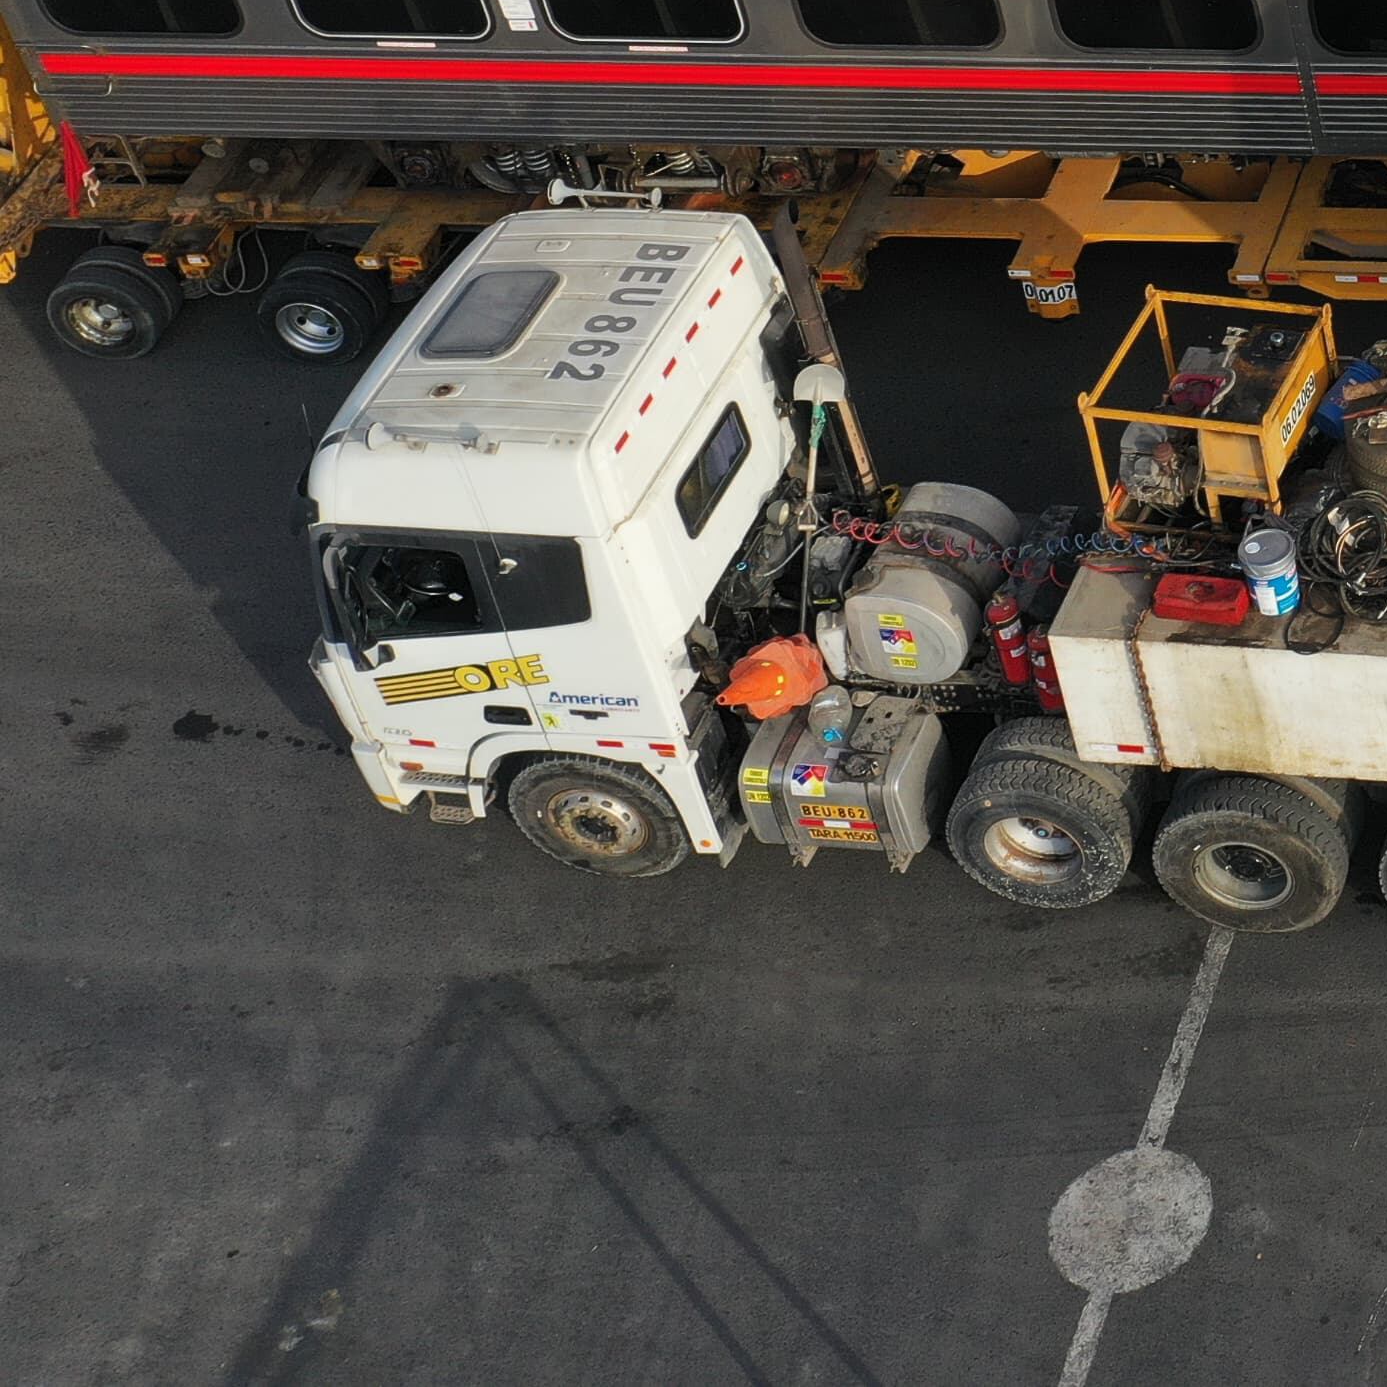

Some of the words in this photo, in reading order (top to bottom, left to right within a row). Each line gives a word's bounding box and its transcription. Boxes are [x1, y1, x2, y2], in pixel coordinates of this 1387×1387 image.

[608, 242, 691, 306] BEU
[549, 314, 638, 381] 862
[1281, 375, 1315, 442] 06.02.069
[454, 653, 549, 693] ORE
[549, 691, 638, 706] American
[810, 829, 841, 838] TARA
